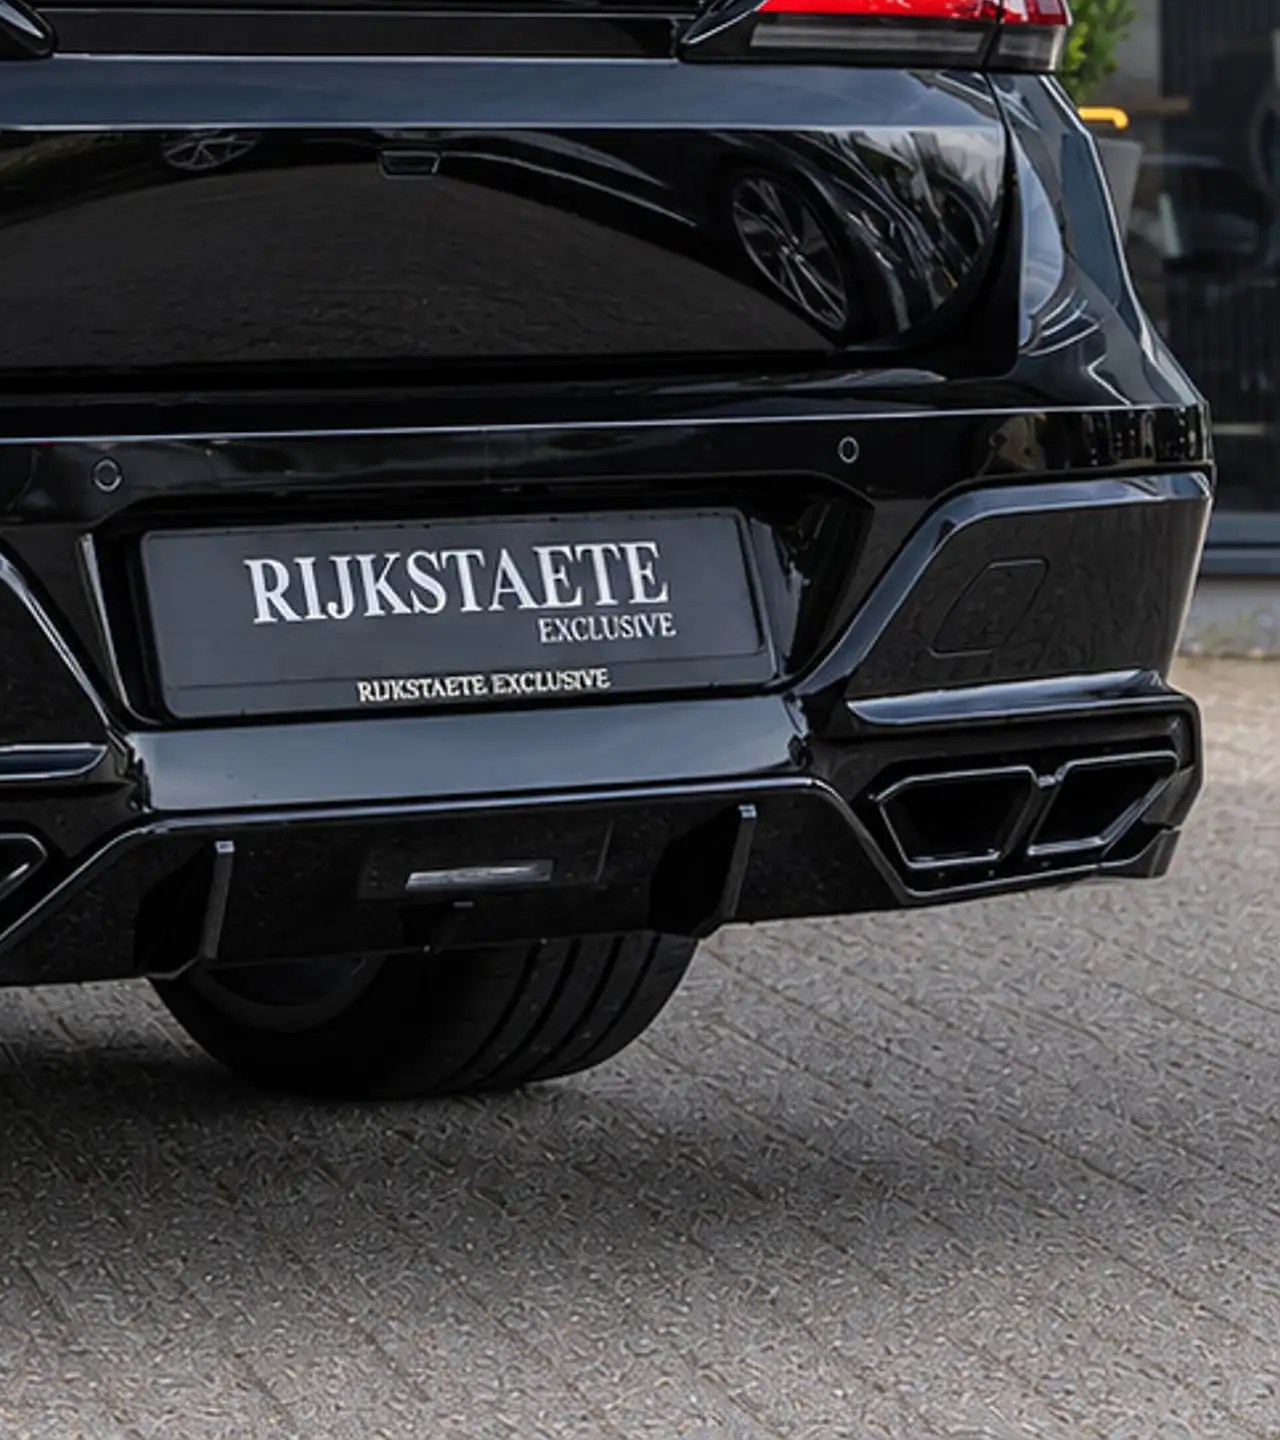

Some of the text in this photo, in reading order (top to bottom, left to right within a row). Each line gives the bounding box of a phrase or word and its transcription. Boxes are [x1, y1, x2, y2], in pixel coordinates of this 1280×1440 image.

[244, 541, 669, 624] RIJKSTAETE
[538, 612, 677, 644] EXCLUSIVE
[357, 668, 611, 703] RIJKSTAETE EXCLUSIVE
